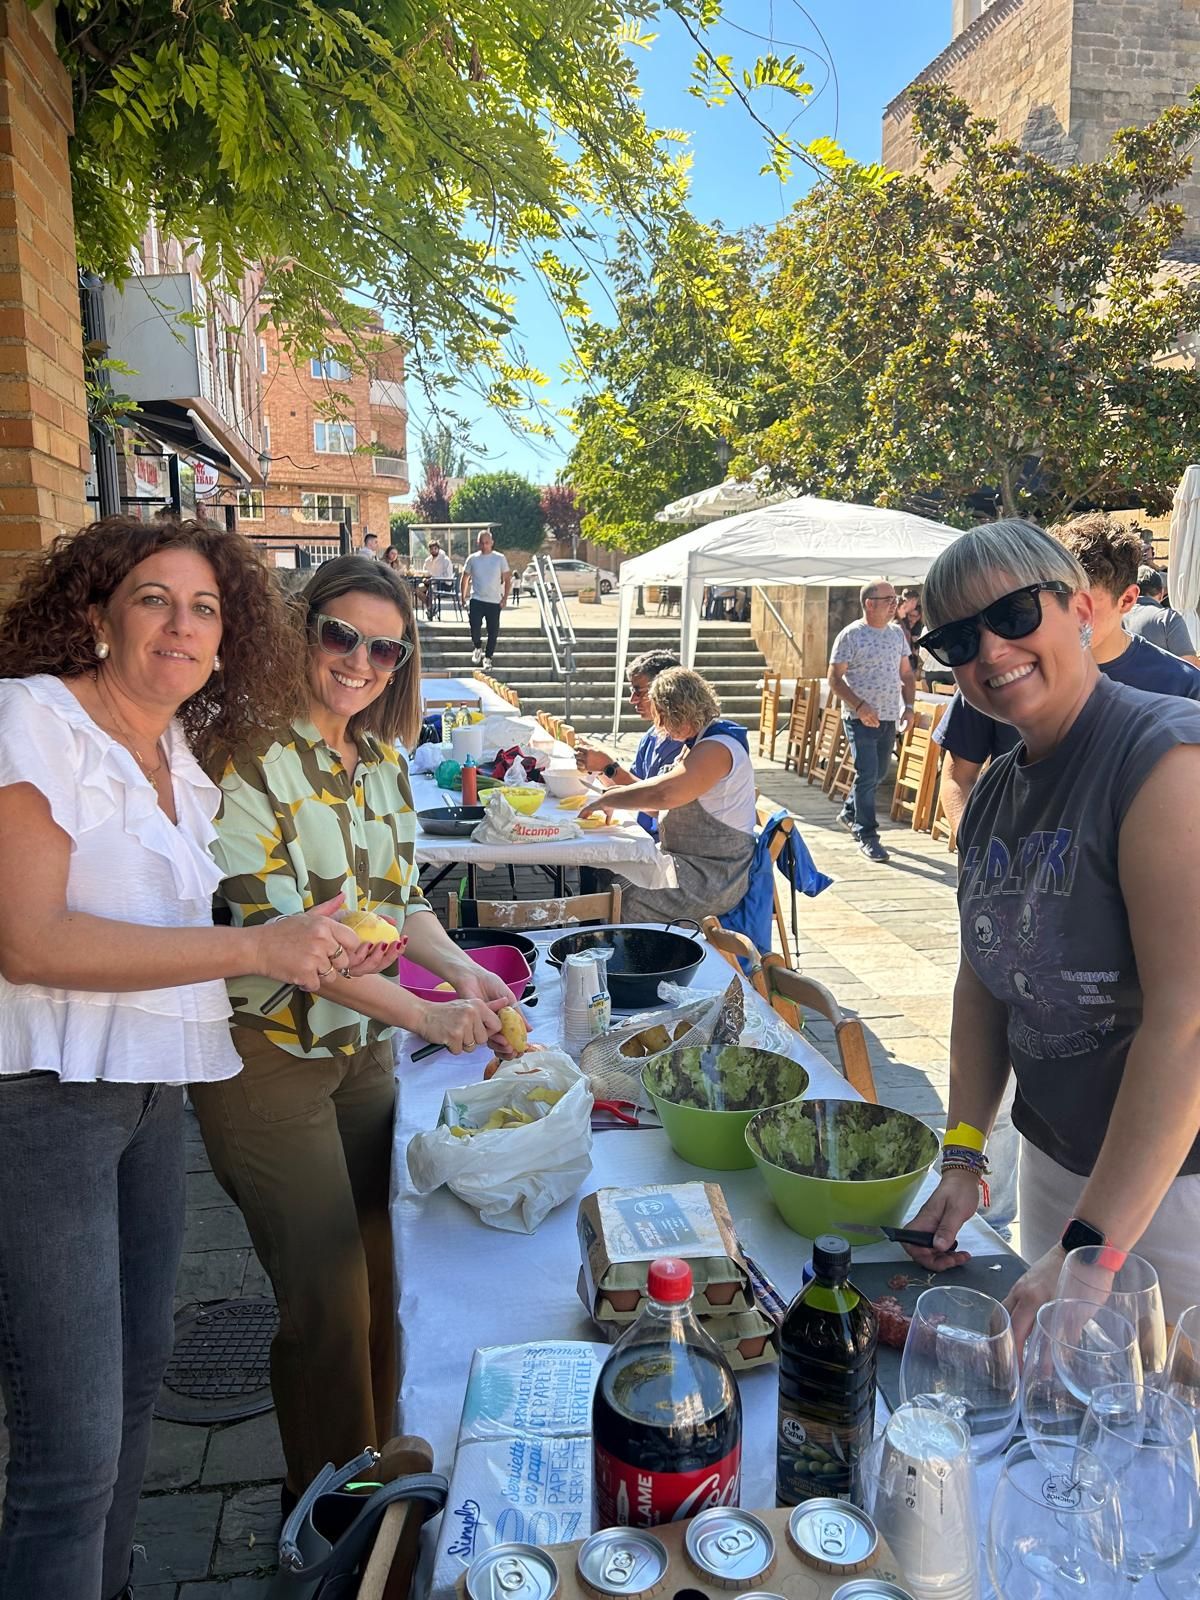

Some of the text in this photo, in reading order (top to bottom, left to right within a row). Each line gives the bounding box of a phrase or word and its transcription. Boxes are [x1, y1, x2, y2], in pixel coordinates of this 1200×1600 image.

[196, 475, 214, 485] EBAB
[512, 823, 560, 838] Alcampo
[532, 1369, 552, 1407] PAPEL
[571, 1359, 592, 1425] SERVETELE
[524, 1484, 538, 1505] en
[447, 1499, 488, 1557] Simply
